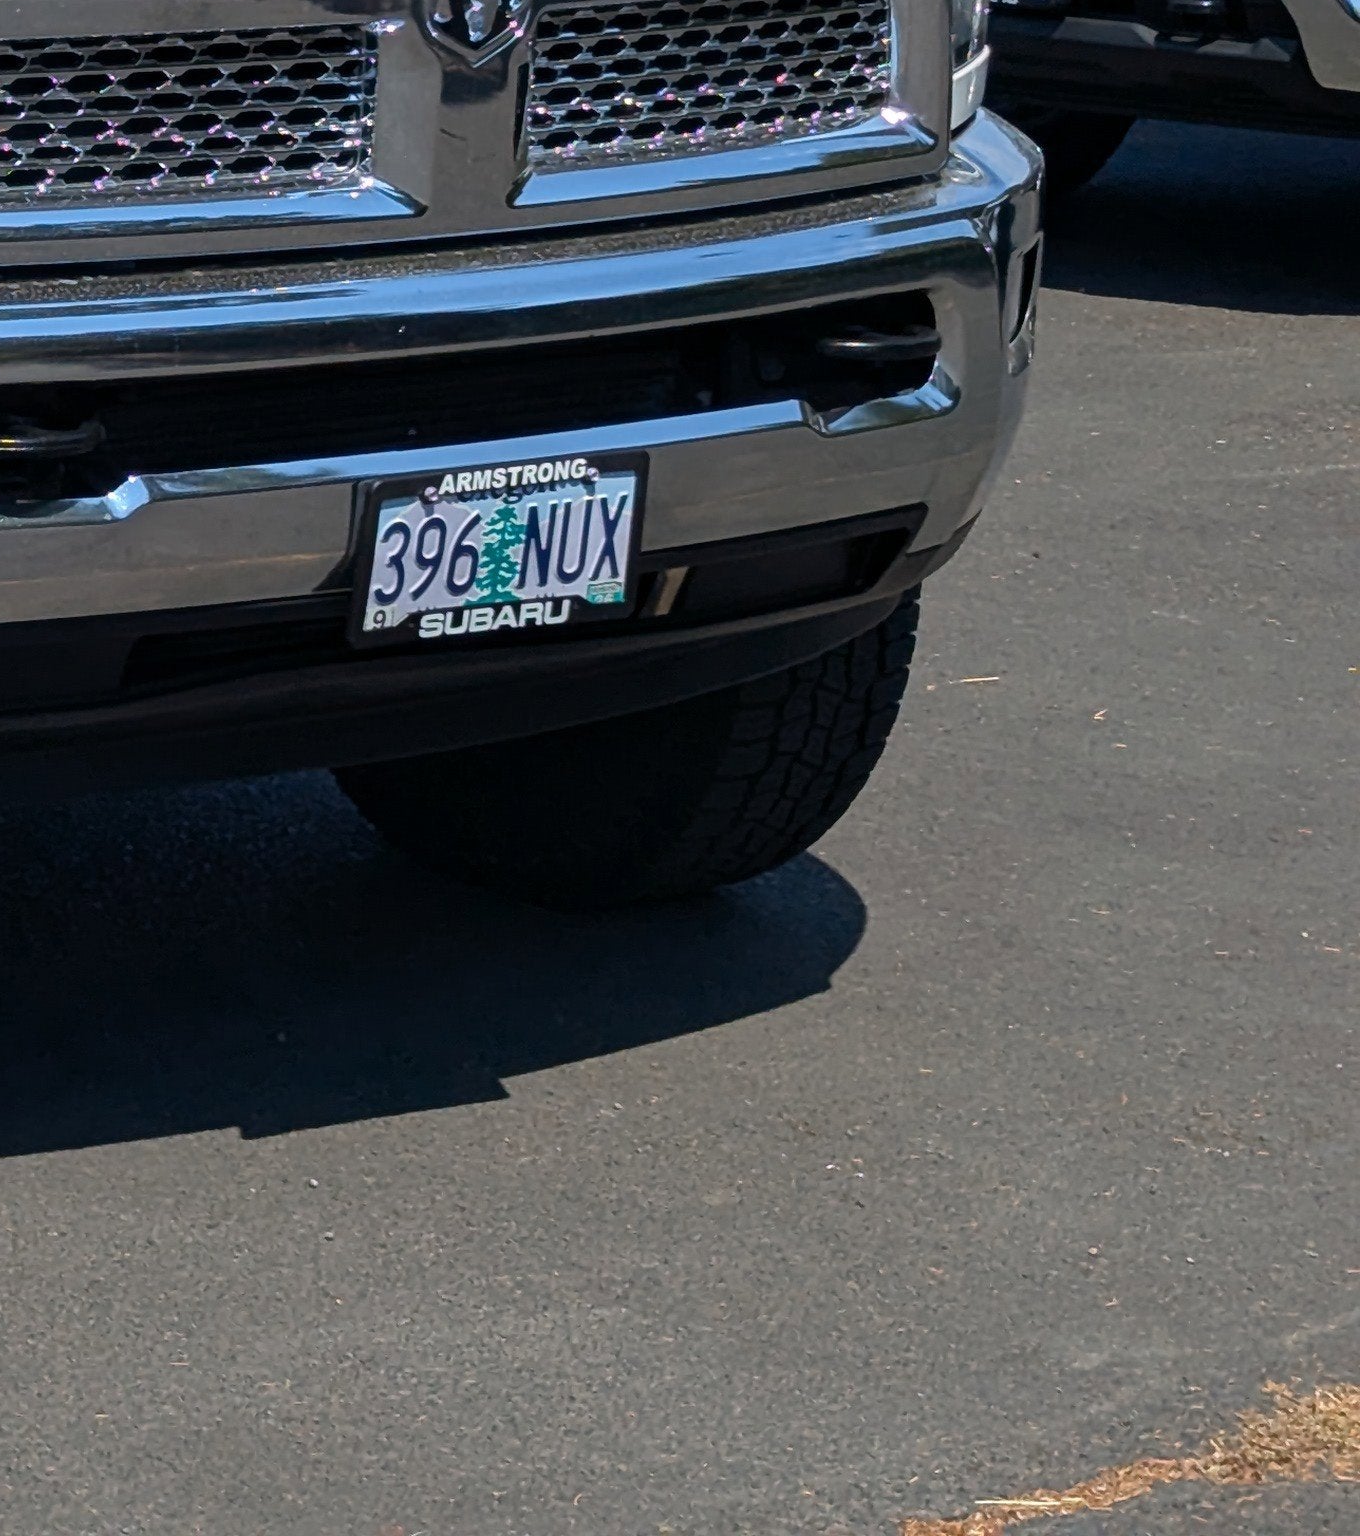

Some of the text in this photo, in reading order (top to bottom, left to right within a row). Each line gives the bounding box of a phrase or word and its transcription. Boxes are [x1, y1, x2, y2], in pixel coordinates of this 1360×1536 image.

[438, 458, 587, 495] ARMSTRONG
[374, 490, 629, 605] 396 NUX
[418, 599, 571, 638] SUBARU
